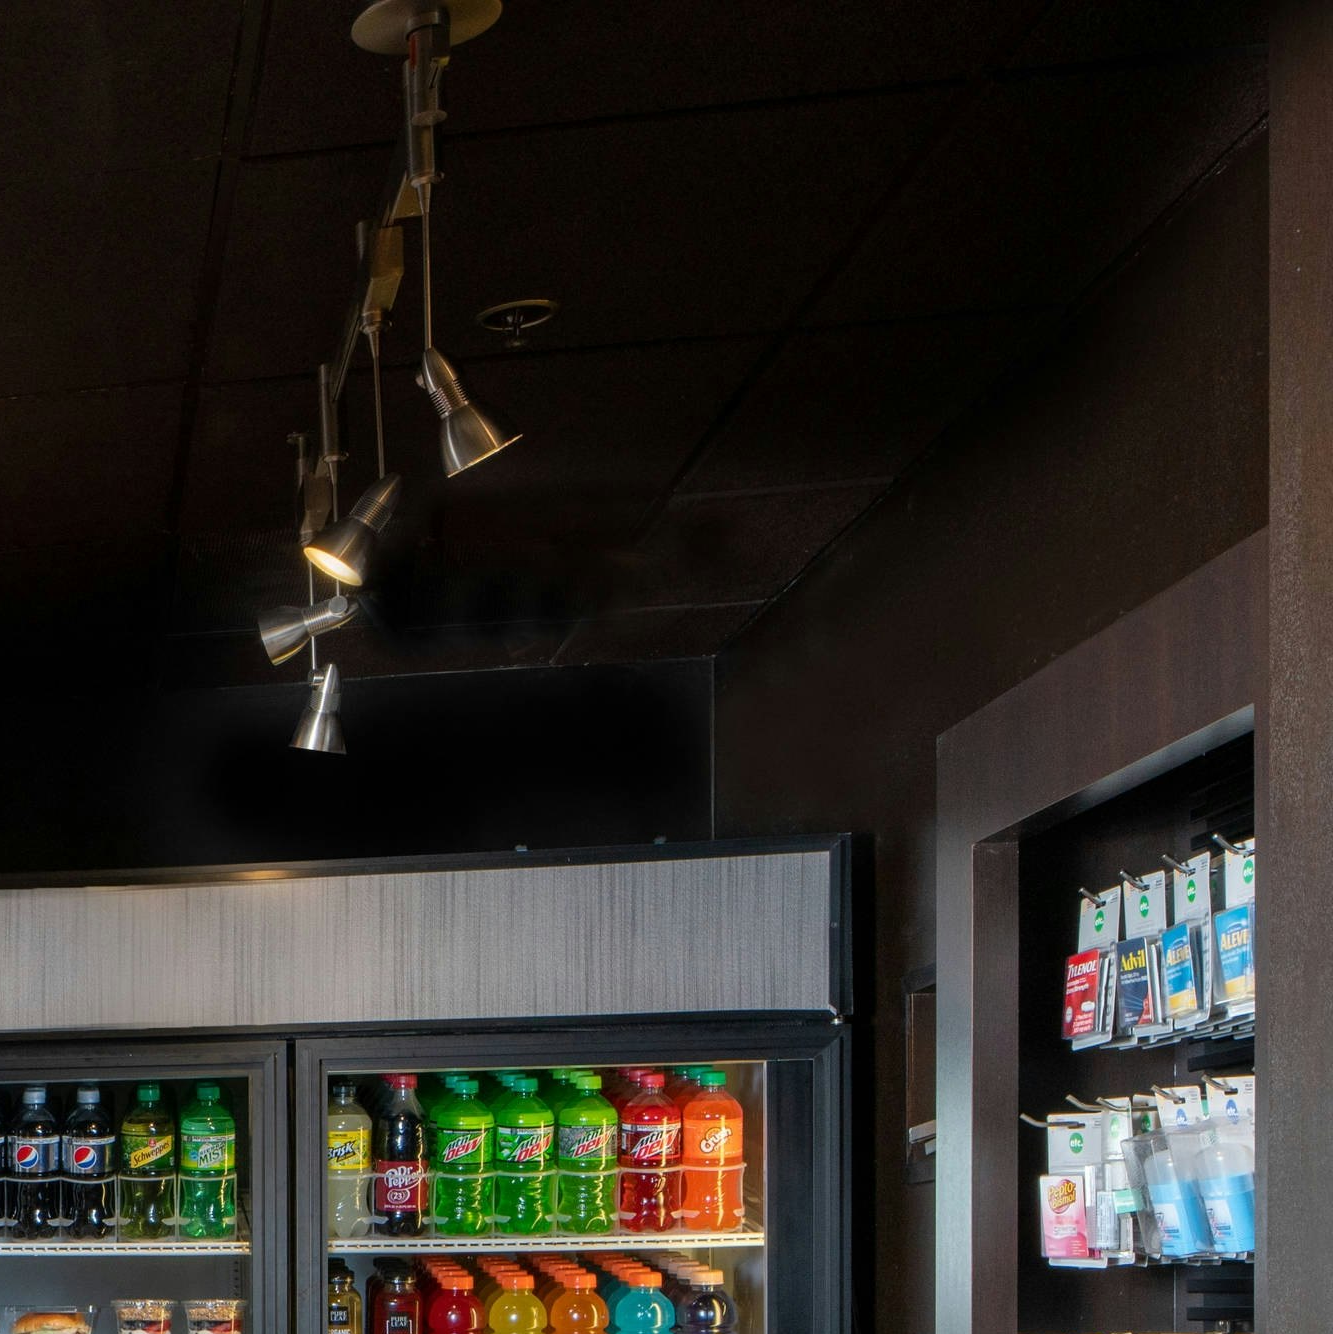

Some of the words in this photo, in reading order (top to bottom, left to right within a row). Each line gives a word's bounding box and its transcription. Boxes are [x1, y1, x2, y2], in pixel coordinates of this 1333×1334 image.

[1067, 959, 1098, 980] TYLENOL
[1120, 949, 1146, 972] Advil
[1070, 1139, 1083, 1148] etc.
[133, 1141, 171, 1167] Schweppes
[199, 1146, 226, 1165] MIST
[393, 1191, 404, 1200] 23
[1048, 1181, 1076, 1199] Pepto-
[1051, 1191, 1077, 1209] Bismol
